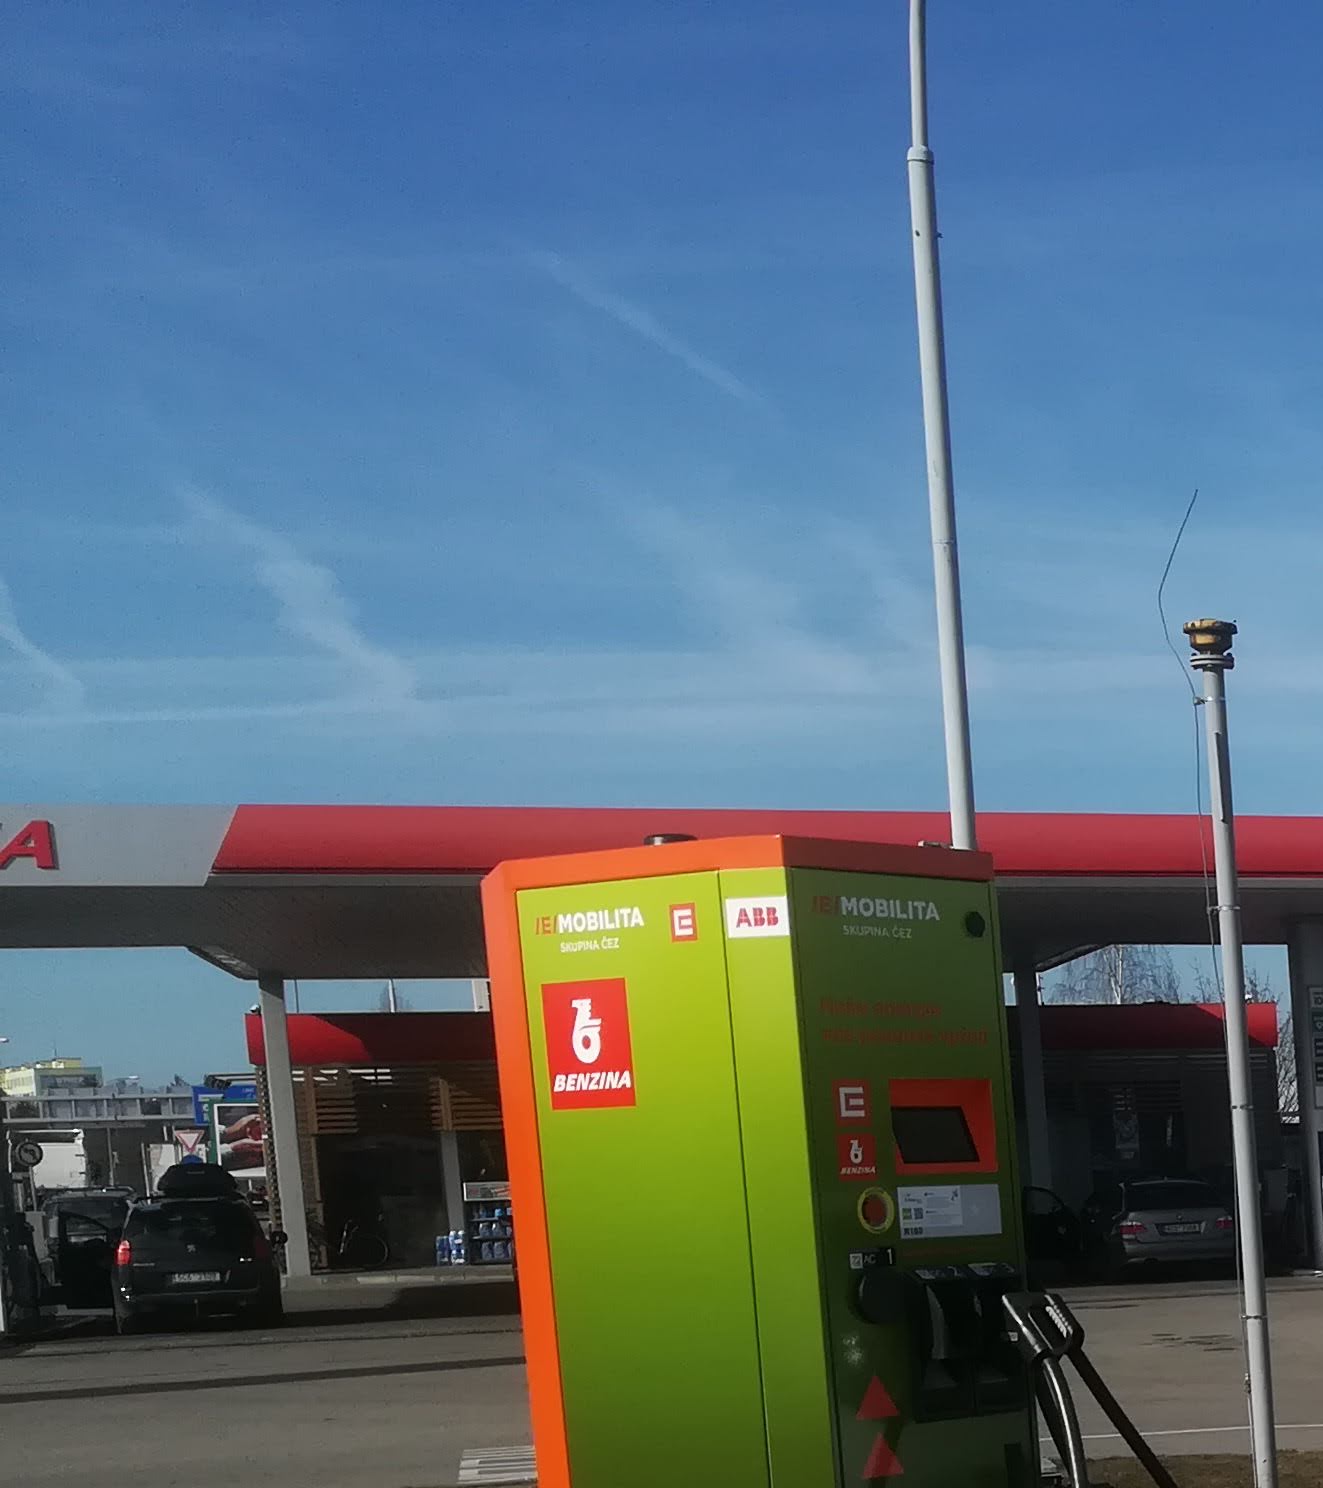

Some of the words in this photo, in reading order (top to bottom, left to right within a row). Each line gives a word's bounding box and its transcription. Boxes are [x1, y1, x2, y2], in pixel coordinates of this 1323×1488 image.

[736, 907, 779, 928] ABB
[843, 924, 889, 938] SKUPINA
[892, 925, 912, 939] ČEZ
[560, 940, 599, 953] SKUPINA
[601, 935, 620, 950] ČEZ
[554, 1070, 632, 1092] BENZINA
